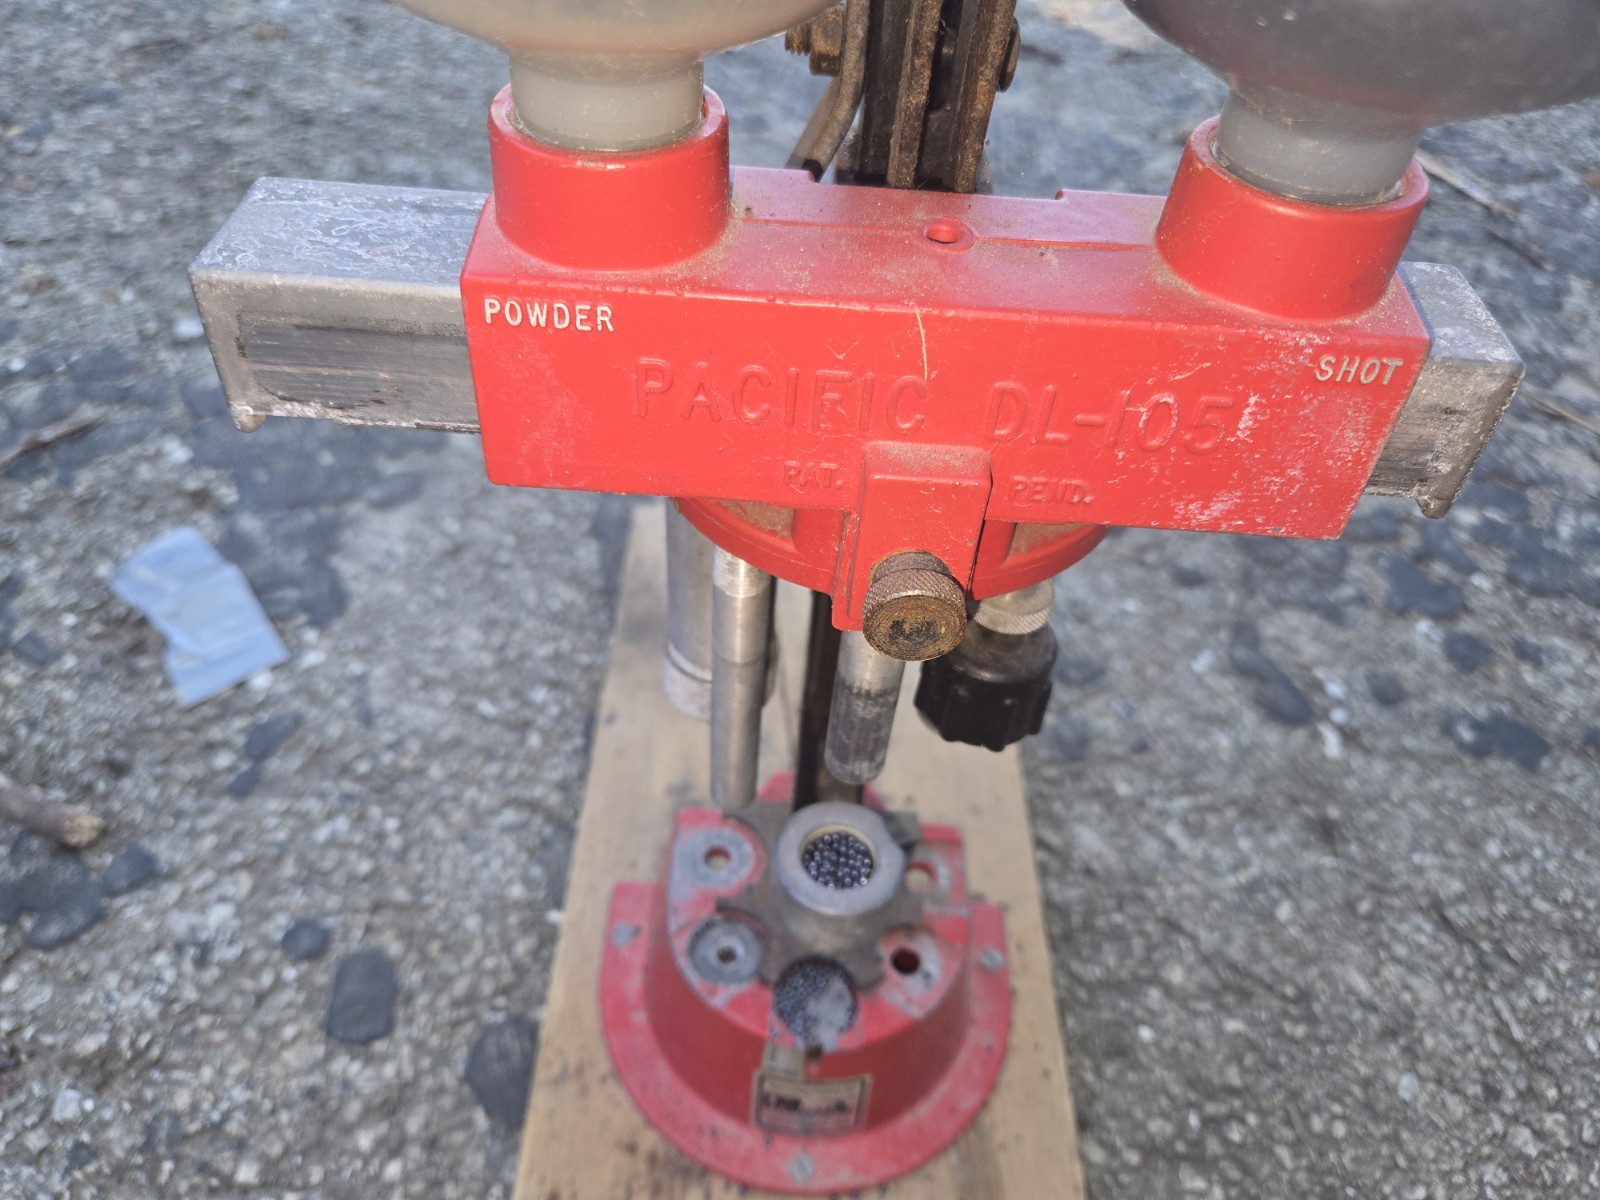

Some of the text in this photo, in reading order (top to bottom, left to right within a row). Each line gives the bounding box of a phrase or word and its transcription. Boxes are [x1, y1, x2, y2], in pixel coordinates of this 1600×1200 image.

[483, 297, 615, 333] POWDER
[1314, 354, 1405, 386] SHOT
[634, 356, 1235, 456] PACIFIC DL-105
[783, 459, 1094, 505] PAT. PEND.
